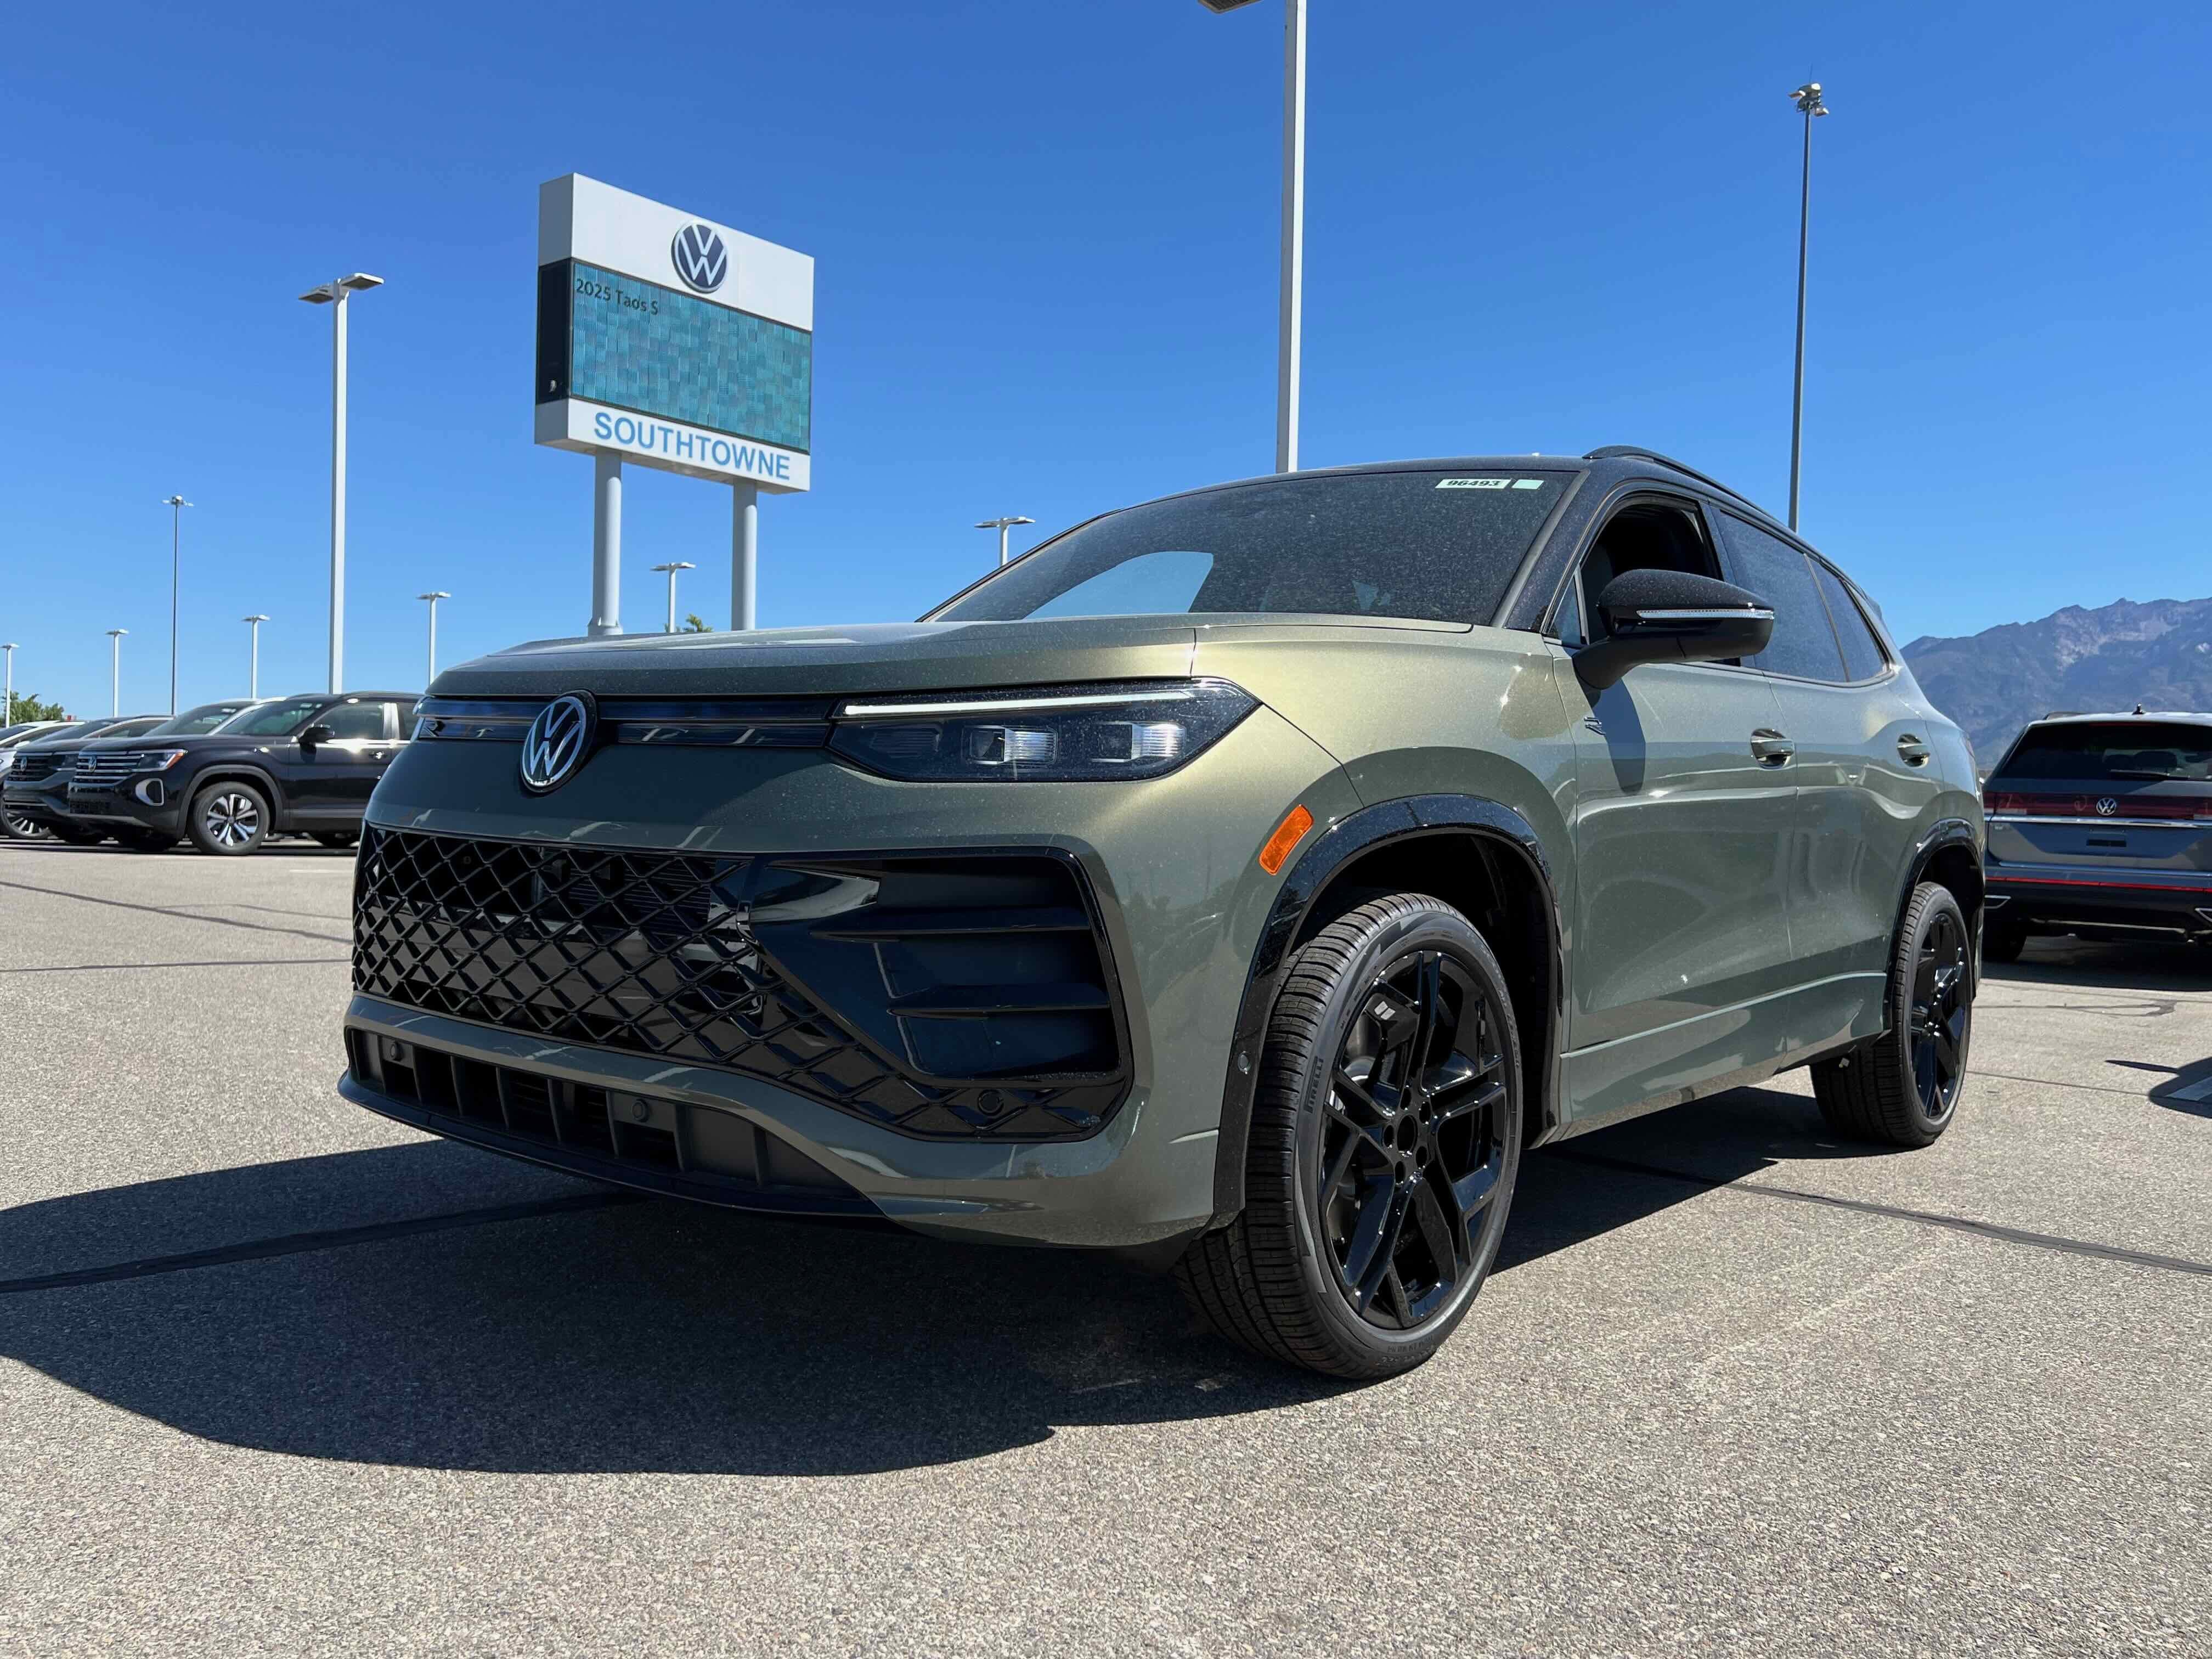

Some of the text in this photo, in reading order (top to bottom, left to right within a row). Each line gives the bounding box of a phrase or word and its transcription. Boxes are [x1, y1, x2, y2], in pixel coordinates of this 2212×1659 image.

[576, 277, 659, 315] 2025 Taos S
[594, 411, 790, 481] SOUTHTOWNE
